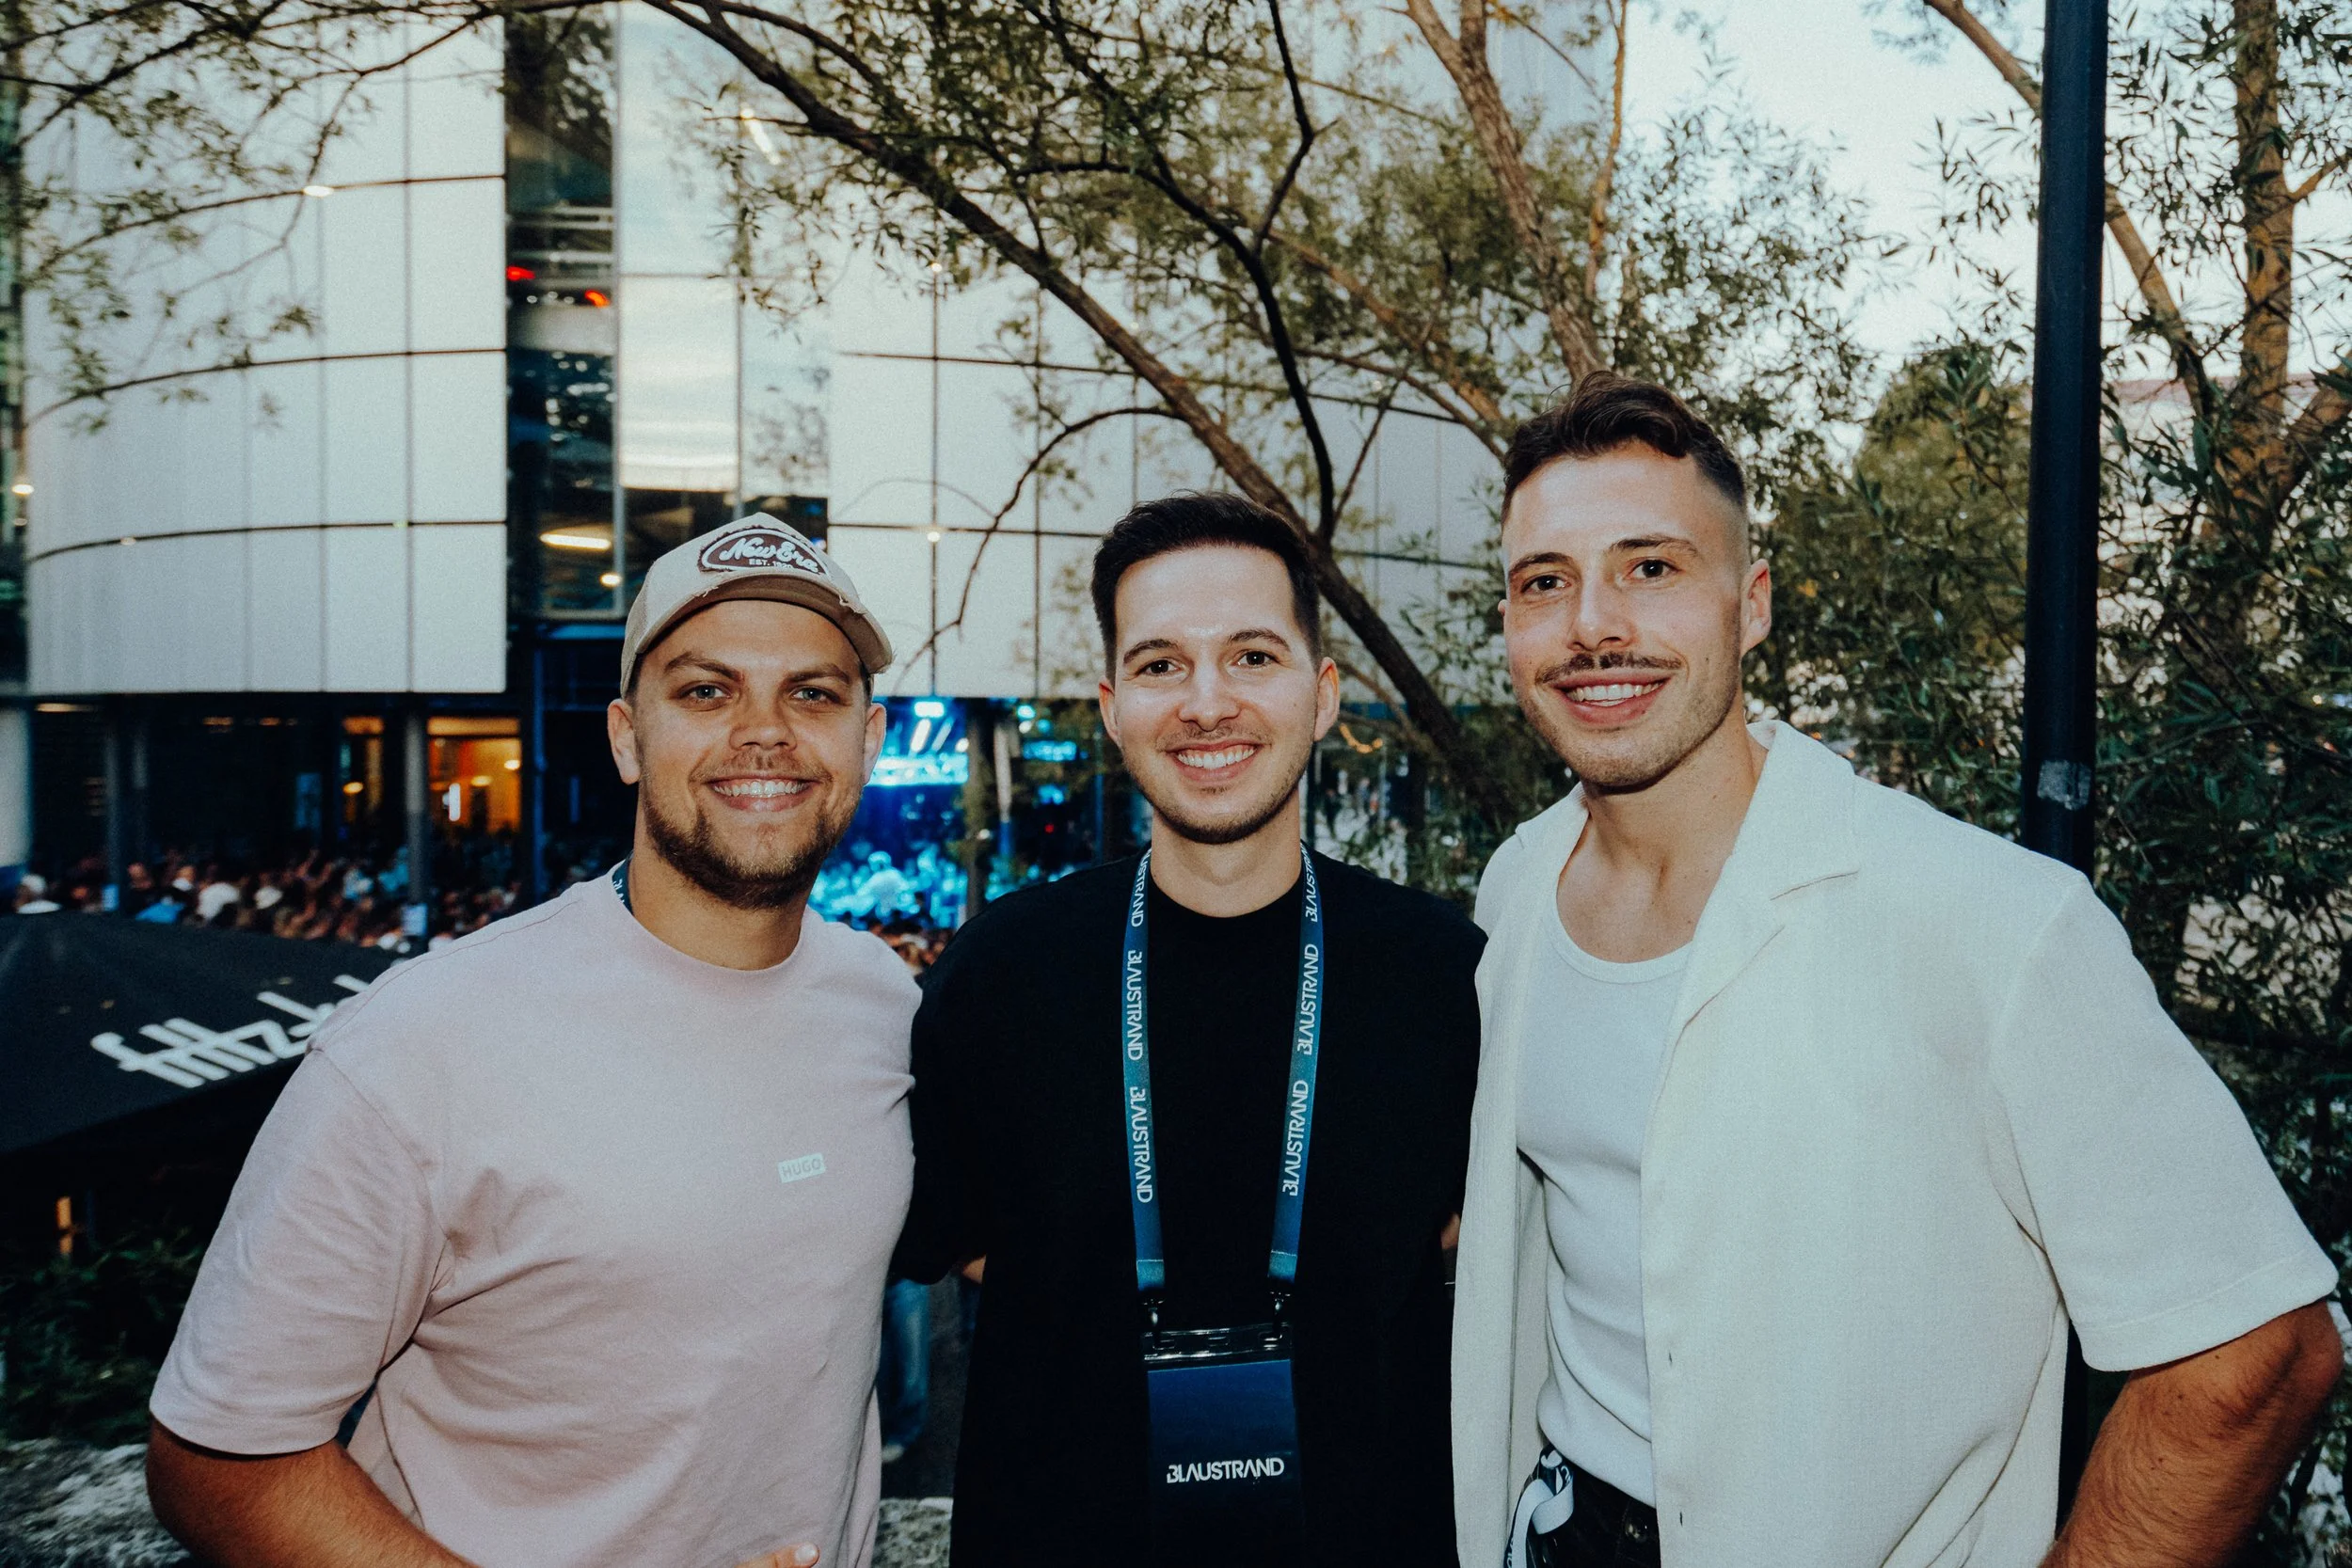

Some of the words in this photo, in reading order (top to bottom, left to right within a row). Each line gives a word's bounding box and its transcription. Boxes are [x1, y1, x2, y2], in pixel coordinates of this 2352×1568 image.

[749, 558, 771, 566] EST.
[1131, 847, 1152, 927] USTRAND
[1300, 842, 1318, 923] BLAUSTRA
[1126, 949, 1143, 1062] BLAUSTRAND
[1296, 943, 1319, 1055] BLAUSTRAND
[781, 1158, 821, 1179] HUGO
[1129, 1086, 1153, 1203] BLAUSTRAND
[1282, 1079, 1309, 1196] BLAUSTRAND
[1167, 1457, 1285, 1483] BLAUSTRAND
